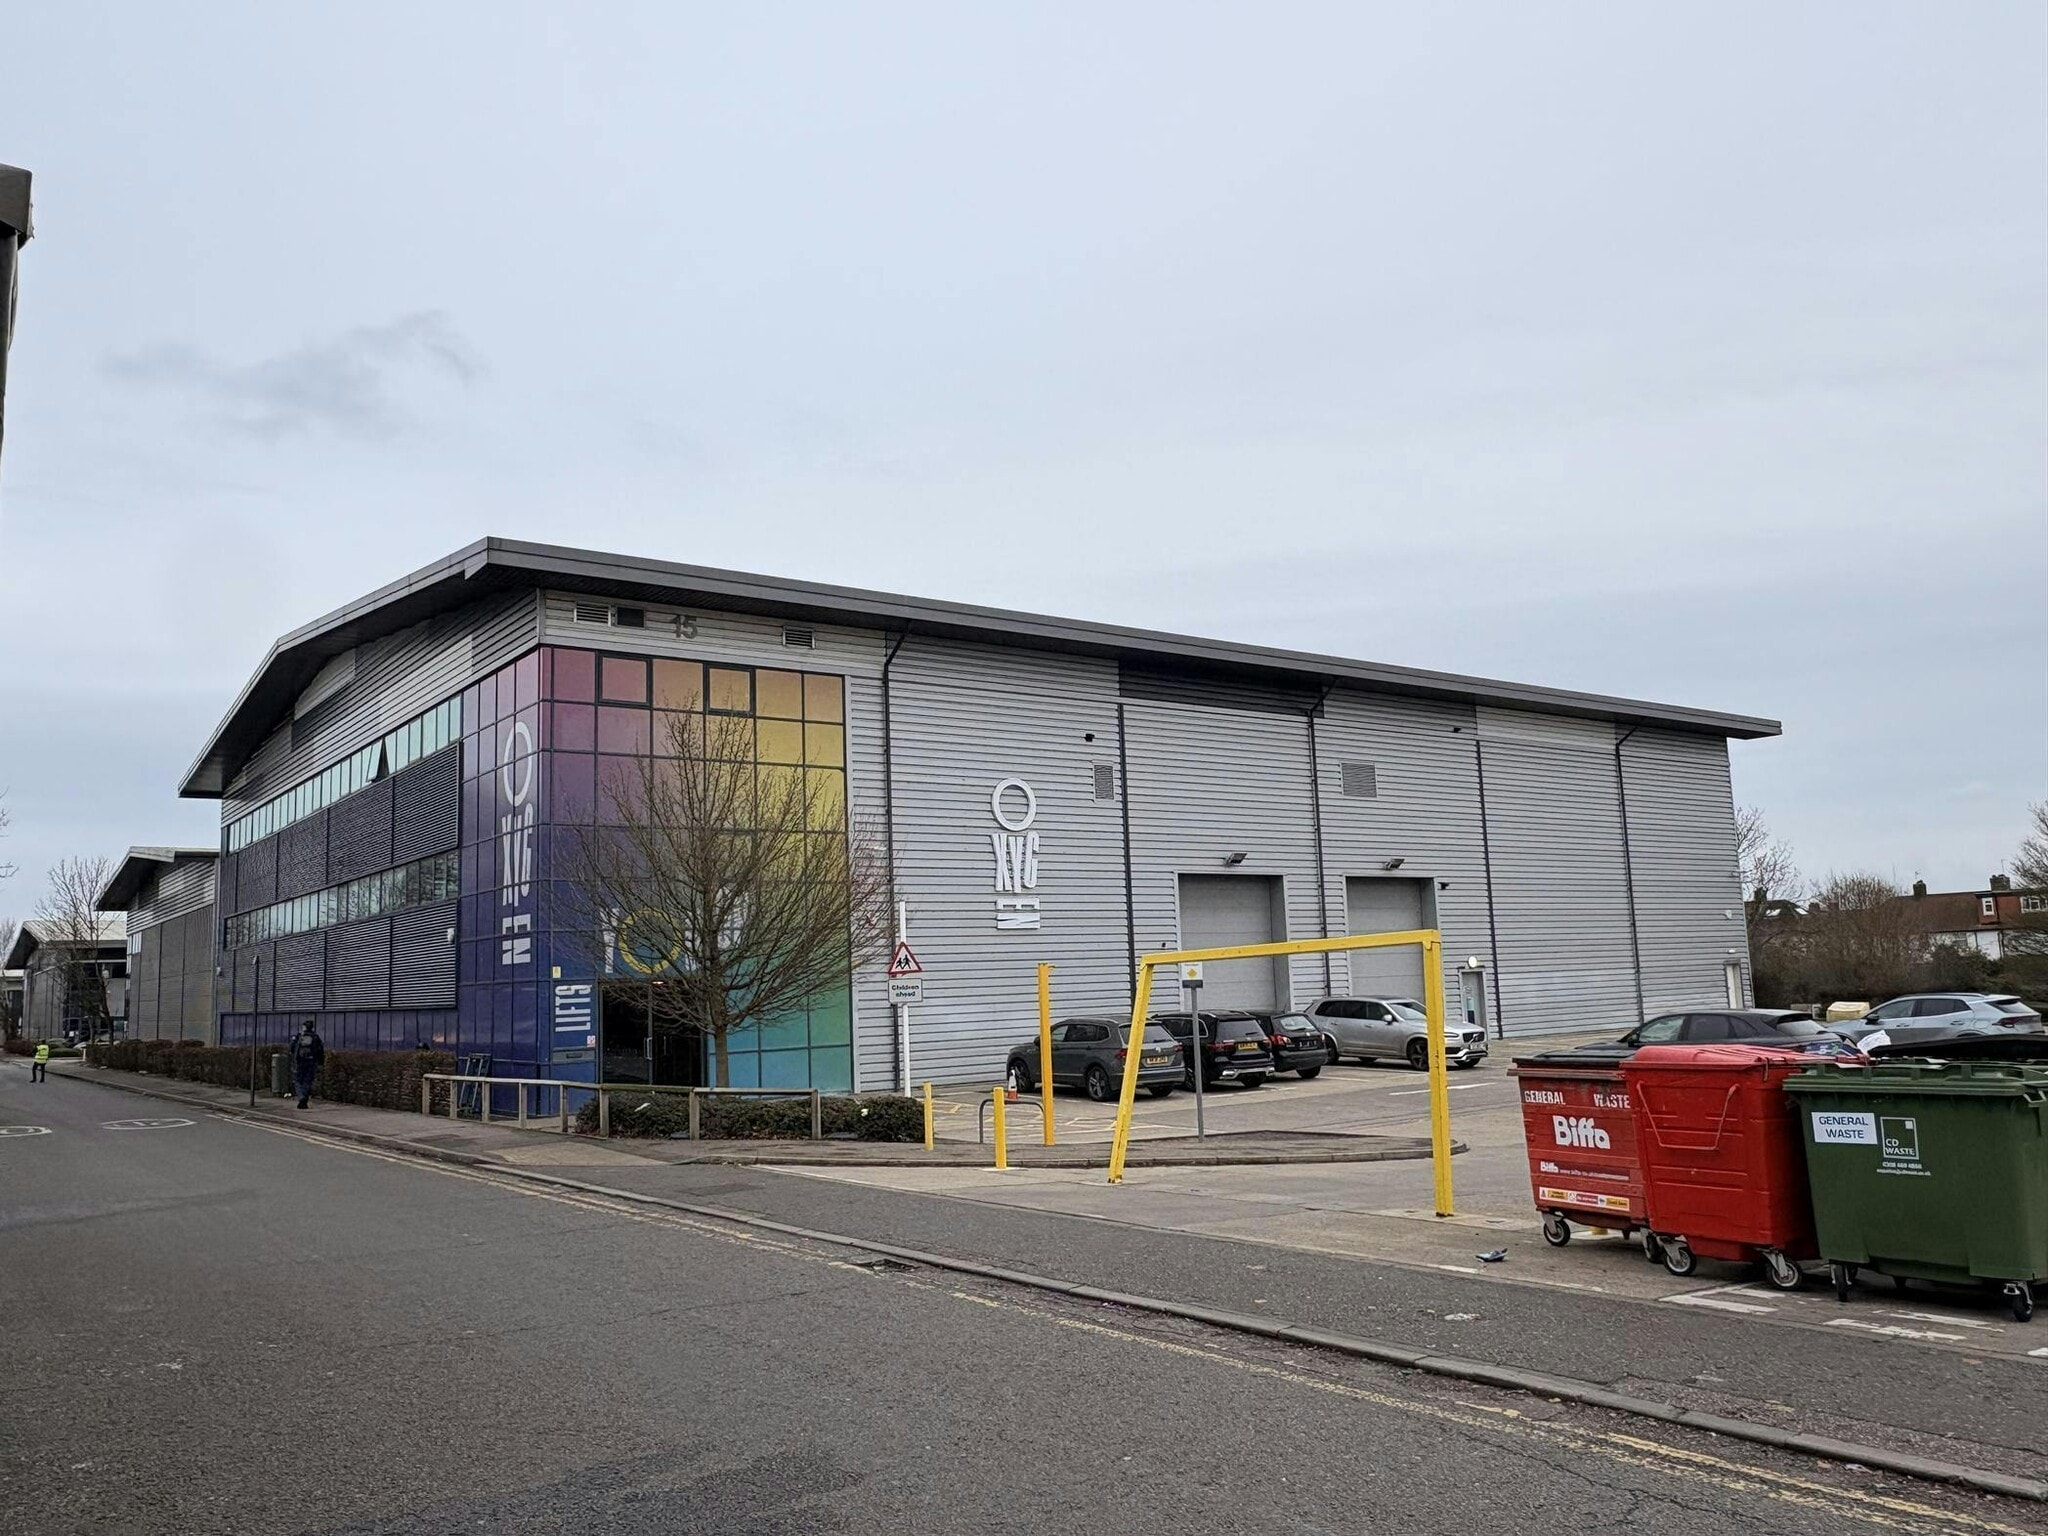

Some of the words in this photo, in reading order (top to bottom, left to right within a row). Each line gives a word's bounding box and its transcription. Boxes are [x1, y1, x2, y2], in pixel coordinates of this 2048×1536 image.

[672, 615, 698, 639] 15
[1524, 1090, 1566, 1105] GENERAL
[1593, 1093, 1631, 1109] WASTE
[1818, 1116, 1869, 1126] GENERAL
[1552, 1115, 1611, 1149] Biffa
[1825, 1128, 1865, 1139] WASTE
[1885, 1138, 1900, 1147] CD
[1884, 1147, 1916, 1156] WASTE
